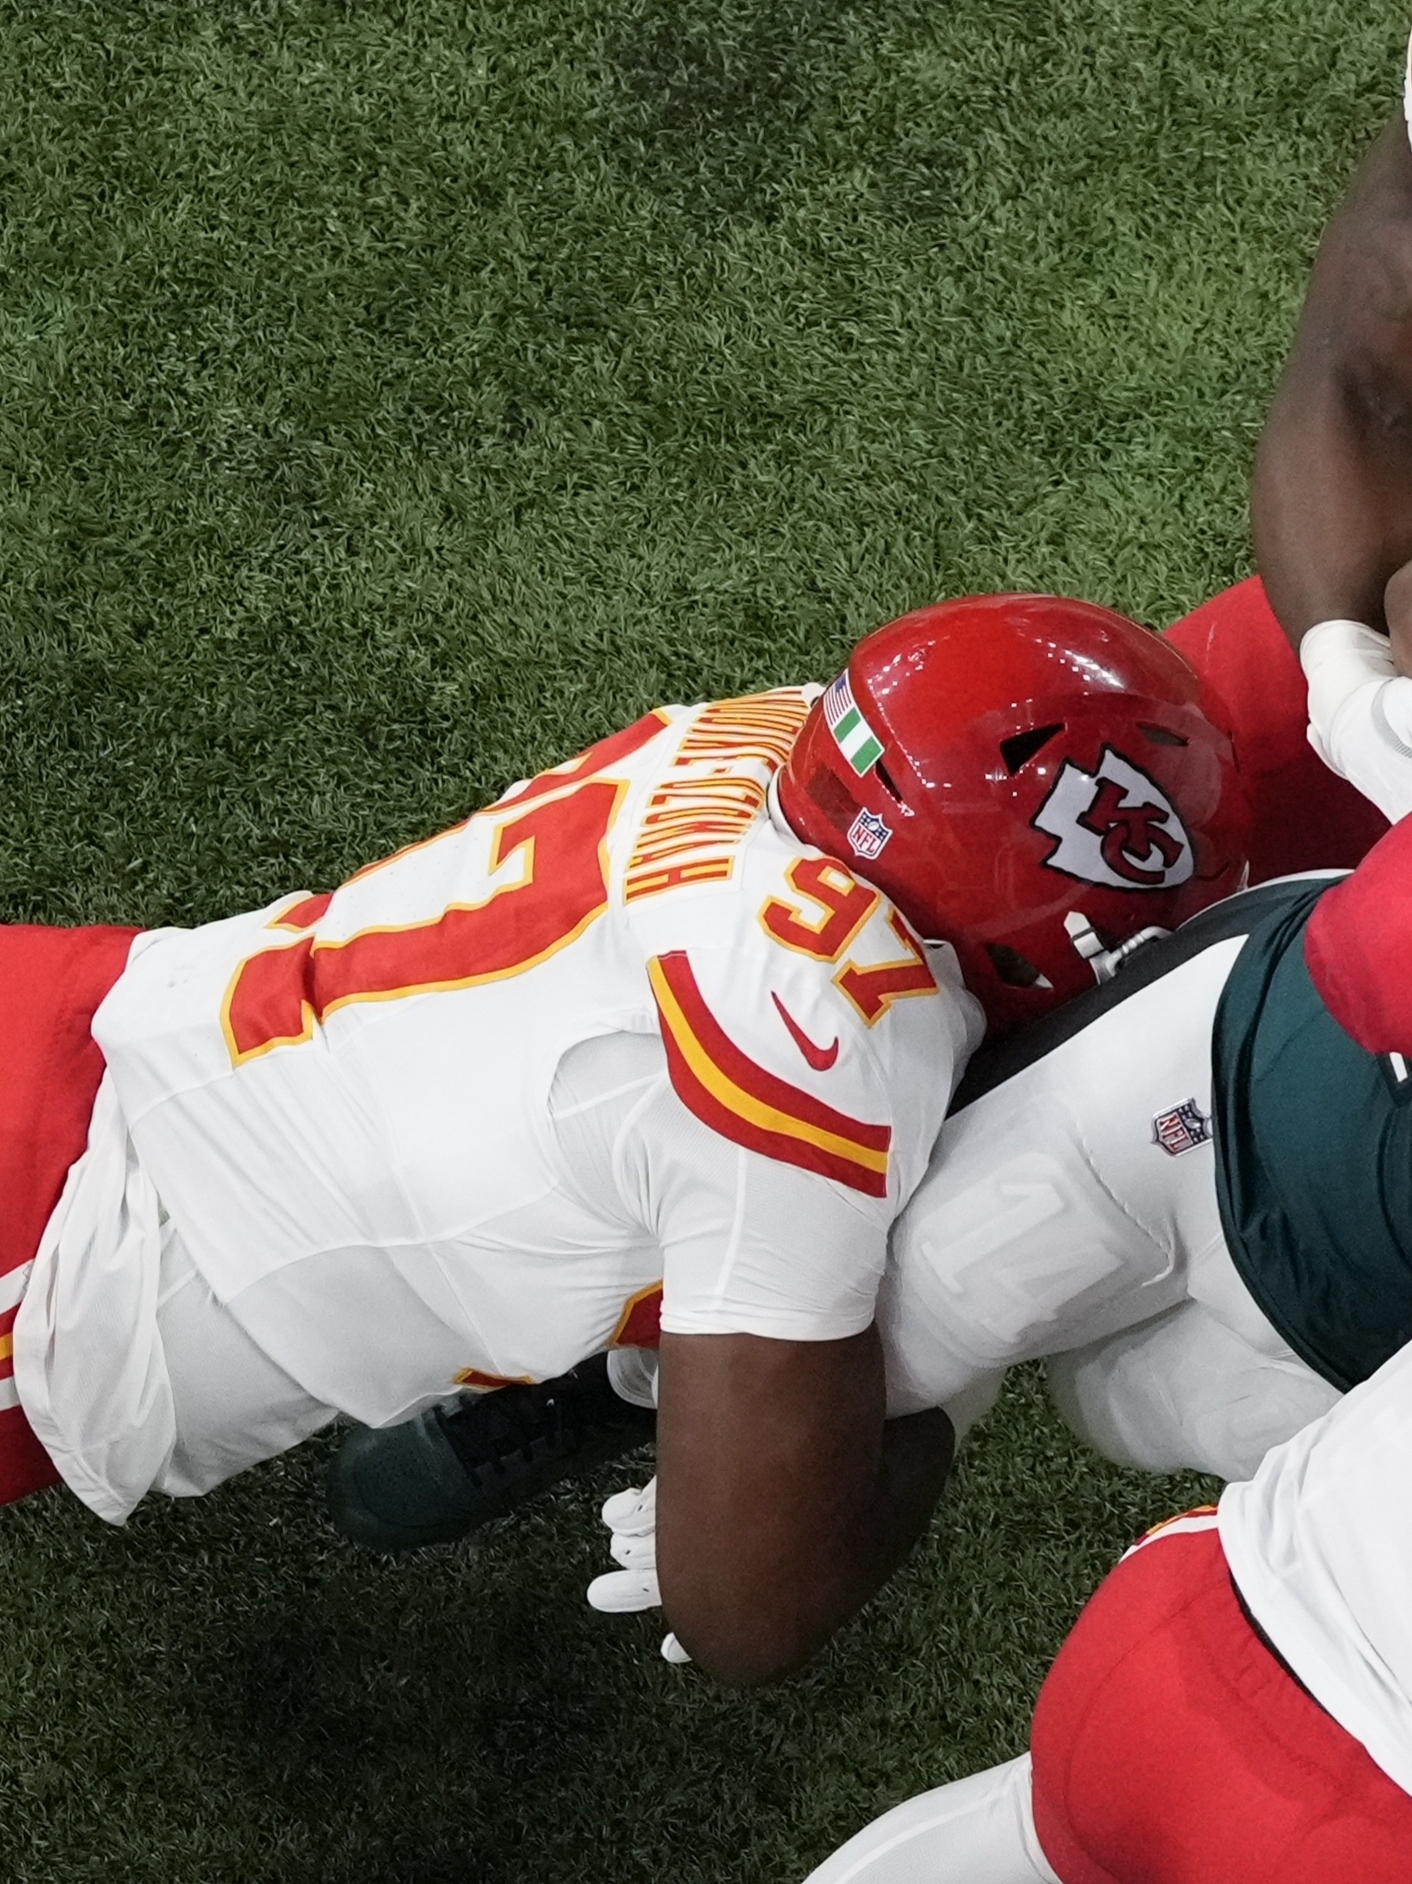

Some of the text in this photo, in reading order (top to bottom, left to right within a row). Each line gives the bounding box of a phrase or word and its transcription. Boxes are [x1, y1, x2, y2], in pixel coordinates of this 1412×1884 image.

[219, 707, 674, 1069] 7
[1076, 766, 1185, 886] KC
[756, 855, 941, 1030] 97
